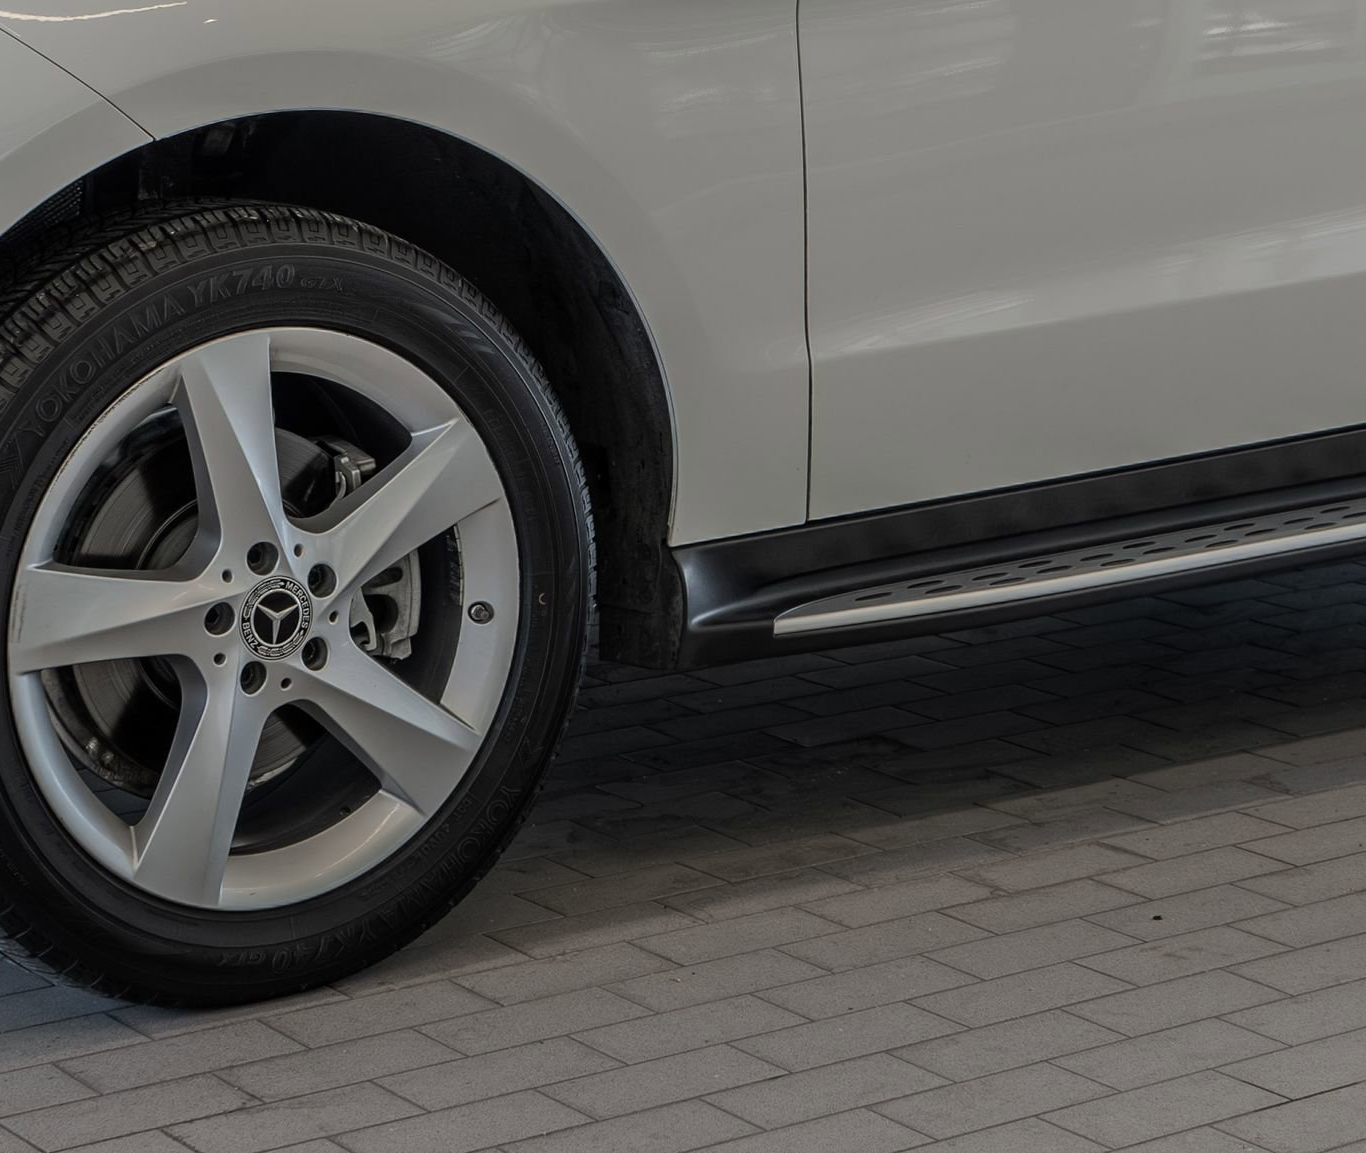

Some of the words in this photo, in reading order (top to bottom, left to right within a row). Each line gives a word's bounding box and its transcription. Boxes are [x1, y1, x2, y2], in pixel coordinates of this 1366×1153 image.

[17, 293, 186, 438] YOKOHAMA
[186, 262, 297, 308] YK740
[242, 622, 259, 649] BENZ
[285, 581, 310, 629] MERCEDES
[380, 784, 523, 930] YOKOHAMA
